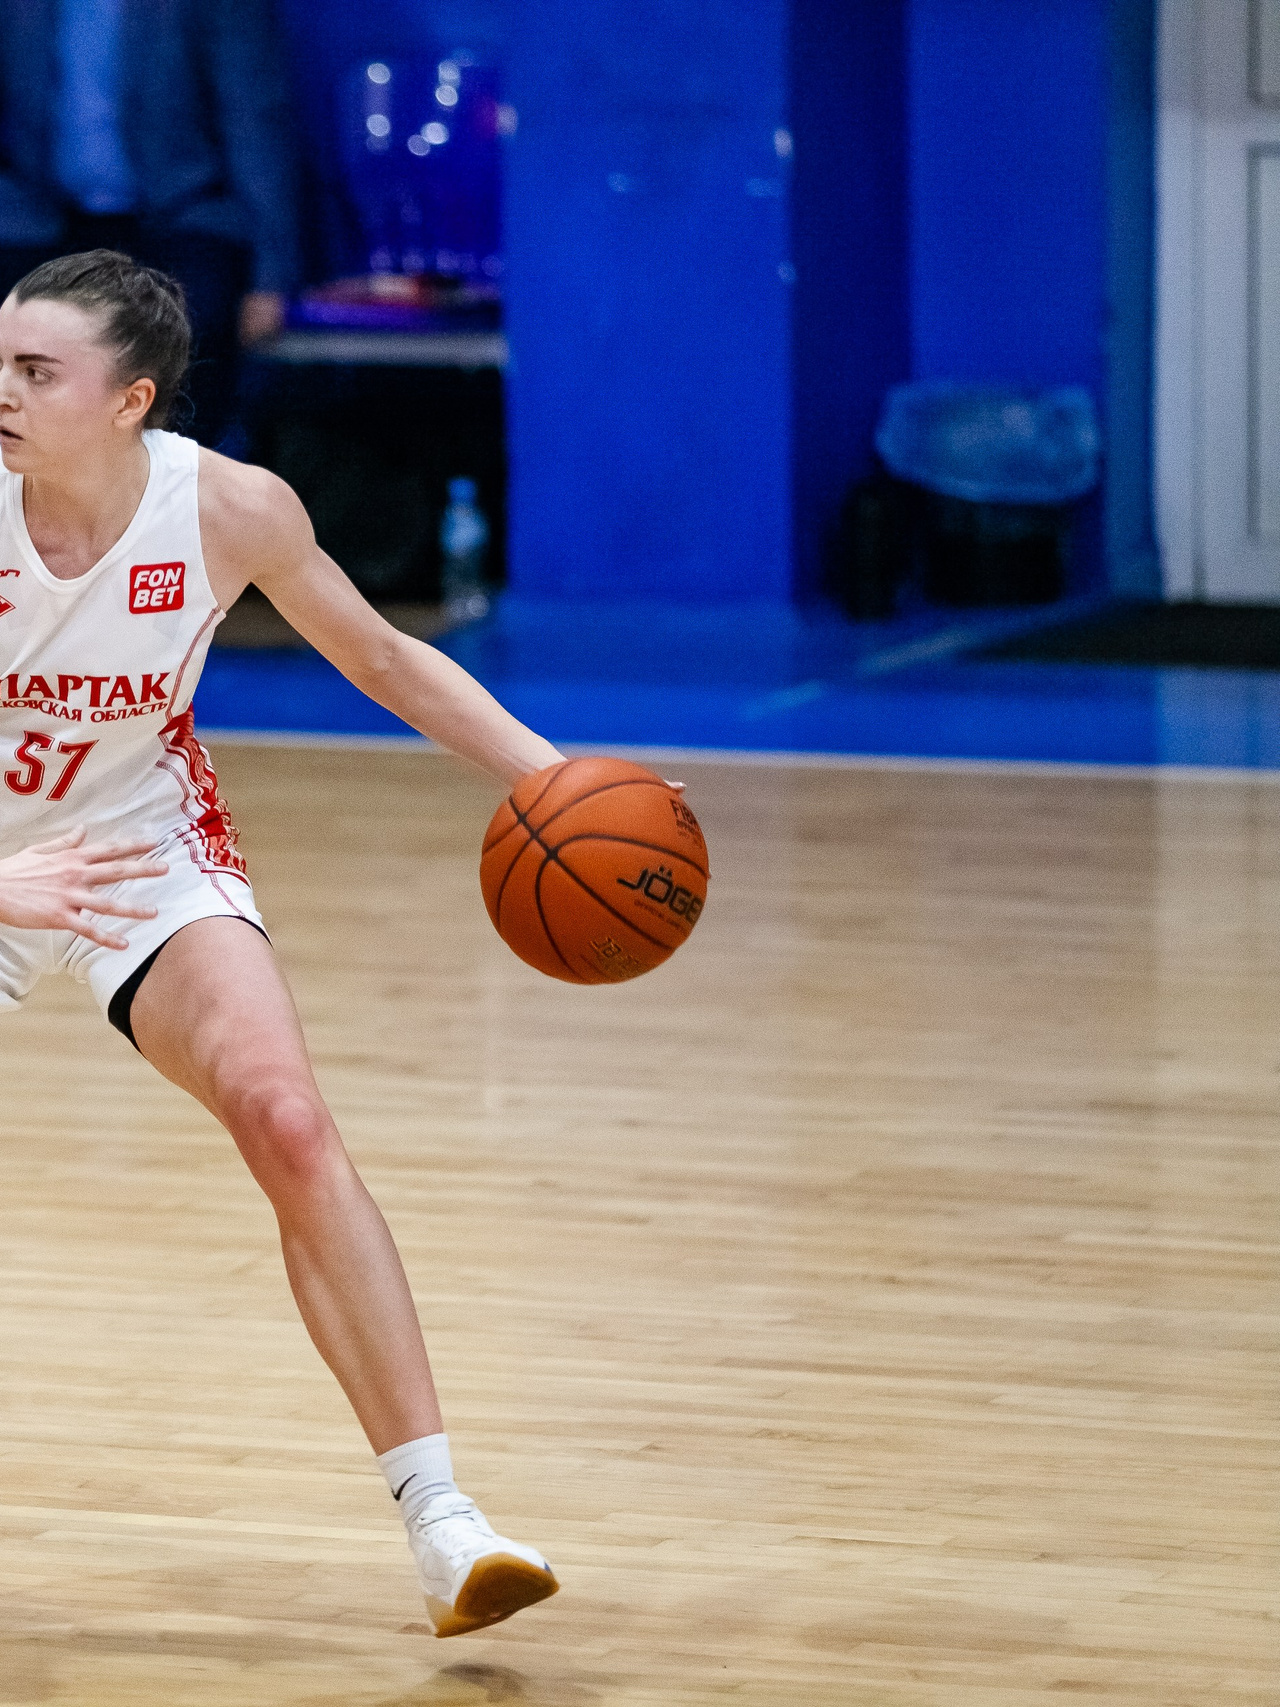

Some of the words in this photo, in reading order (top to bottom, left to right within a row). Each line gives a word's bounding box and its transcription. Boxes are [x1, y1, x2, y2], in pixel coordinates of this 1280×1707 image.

[133, 567, 182, 589] FON
[133, 585, 180, 608] BET
[90, 701, 168, 723] ОБЛАСТЬ
[4, 730, 100, 801] 57
